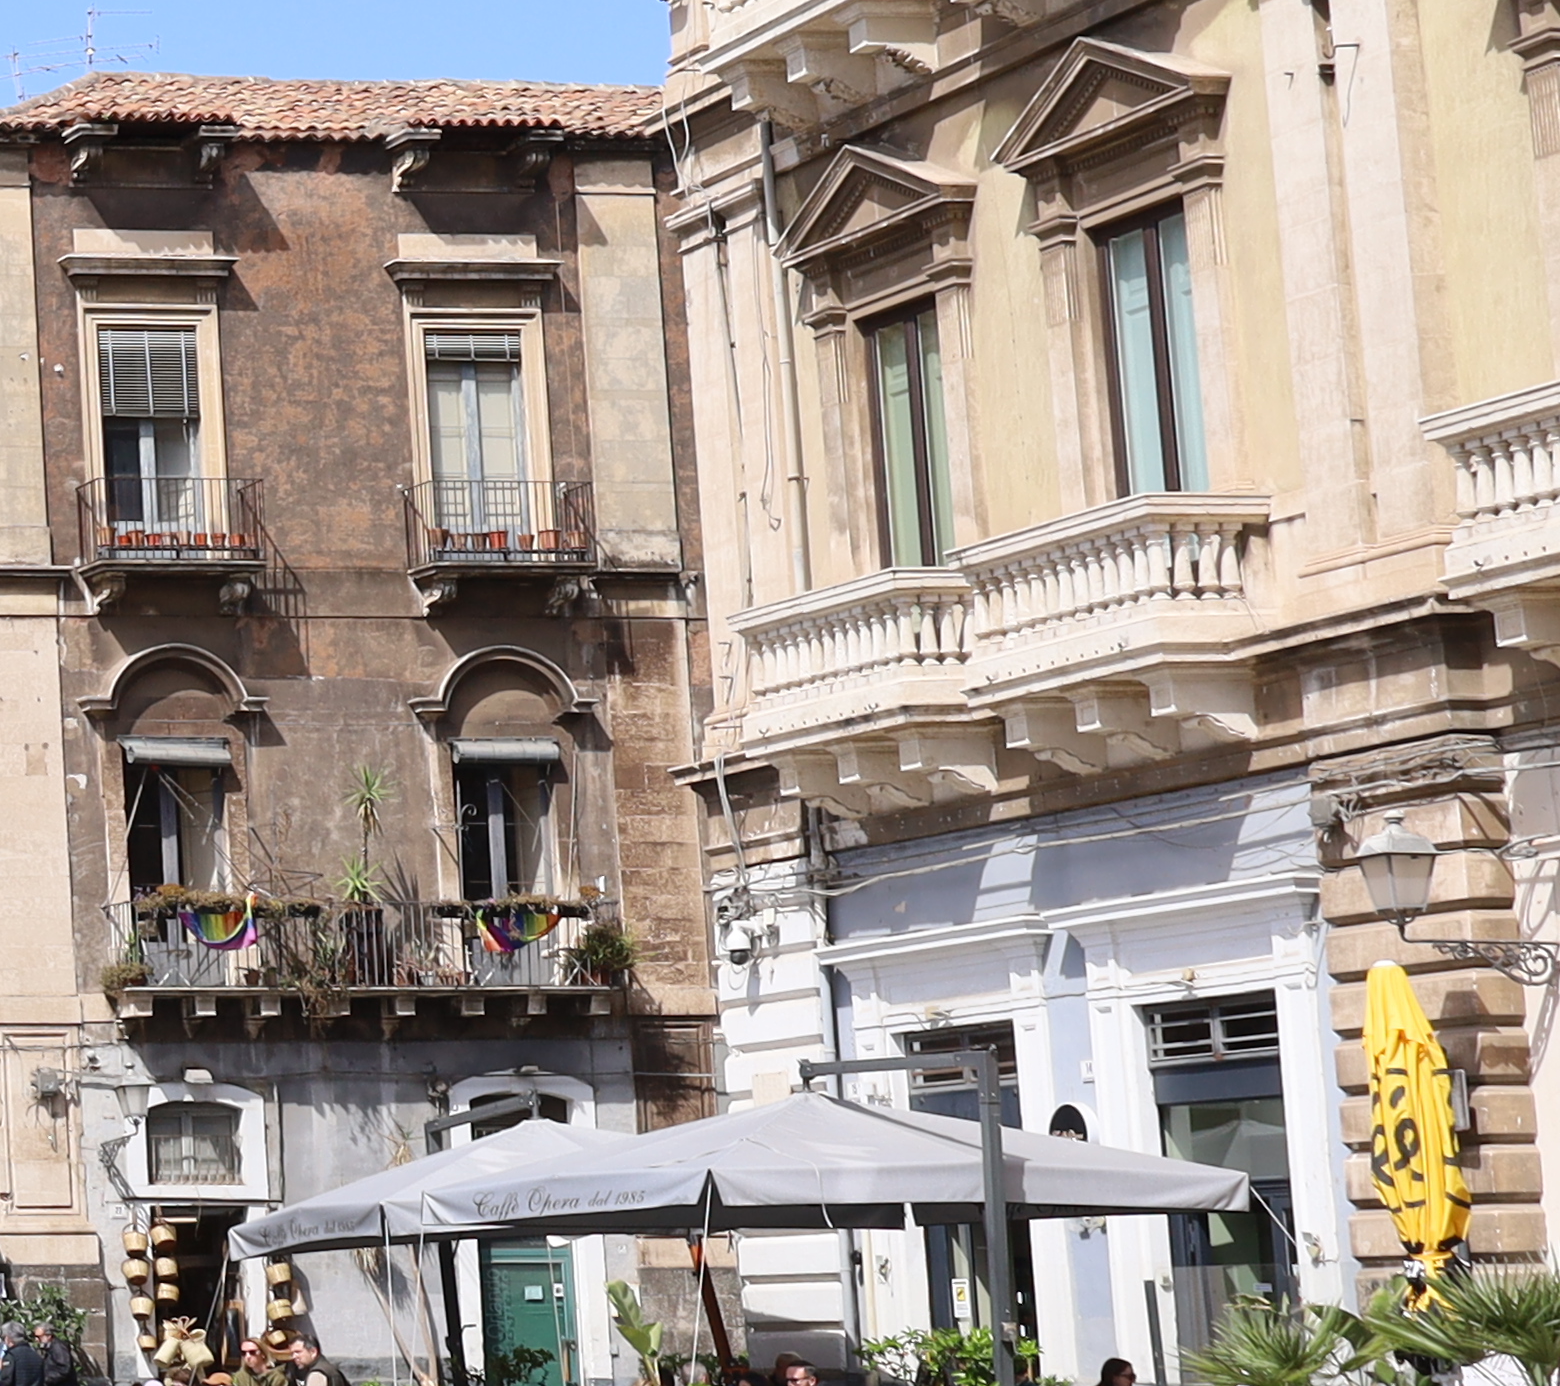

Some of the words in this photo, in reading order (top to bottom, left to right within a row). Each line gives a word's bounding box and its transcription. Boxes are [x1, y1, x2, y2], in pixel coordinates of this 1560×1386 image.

[473, 1191, 519, 1221] Caffè
[527, 1186, 581, 1215] Opera
[588, 1190, 612, 1207] dal
[615, 1190, 647, 1206] 1985
